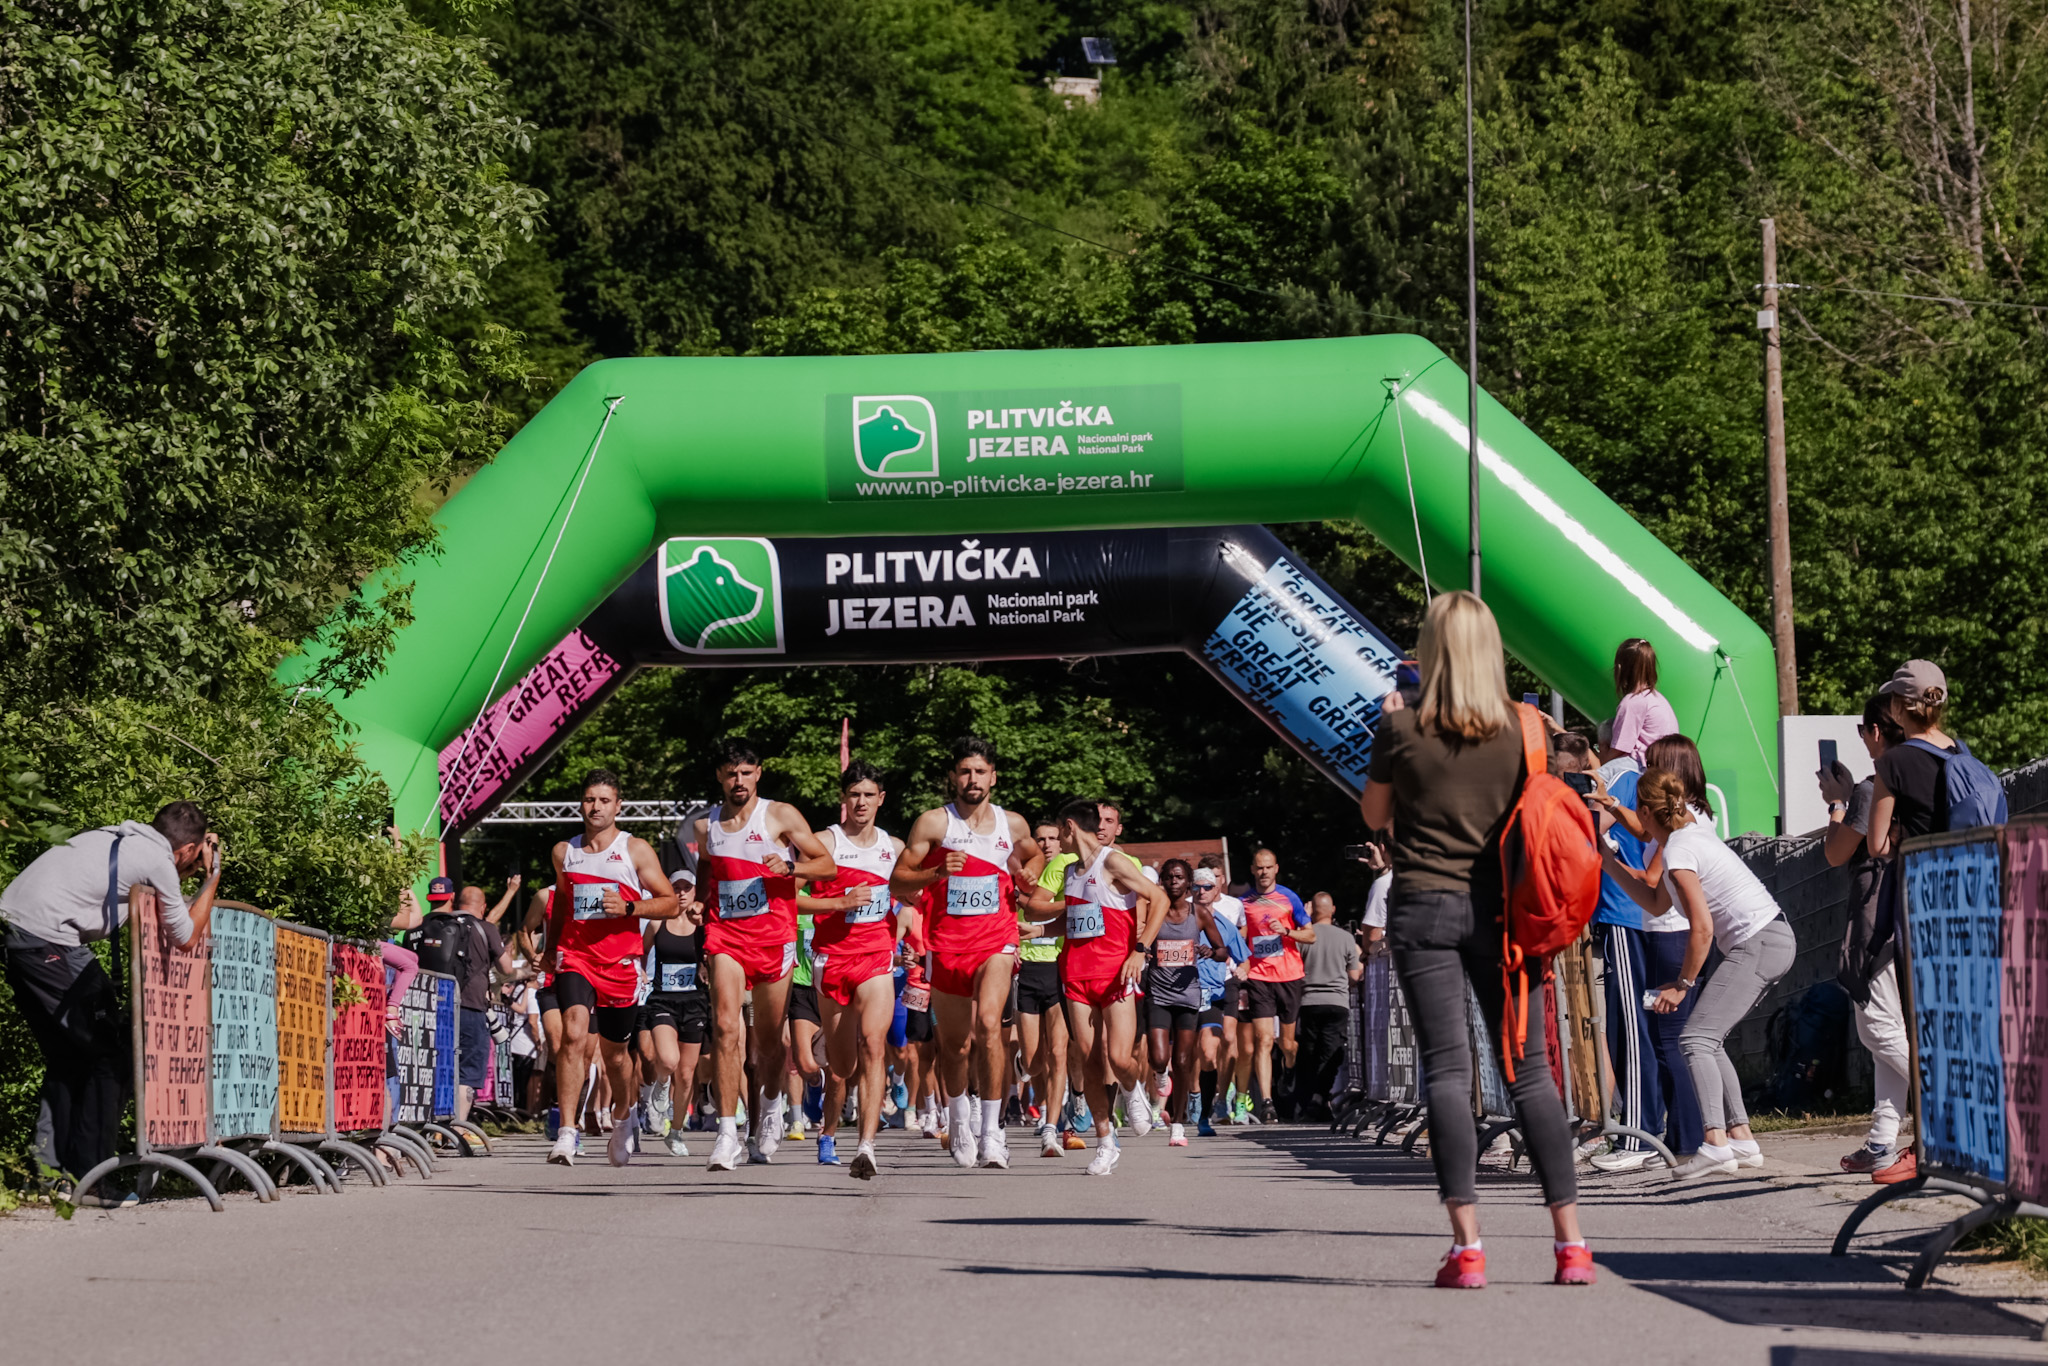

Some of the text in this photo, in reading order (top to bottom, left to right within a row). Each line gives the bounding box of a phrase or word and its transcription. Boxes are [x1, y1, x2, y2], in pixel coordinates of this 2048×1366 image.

[968, 400, 1114, 430] PLITVIČKA
[1077, 432, 1153, 444] Nacionalni park
[966, 435, 1070, 462] JEZERA
[1078, 443, 1144, 455] National Park
[856, 470, 1154, 498] www.np-plitvicka-jezera.hr
[825, 539, 1041, 585] PLITVIČKA
[987, 590, 1099, 609] Nacionalni park
[1281, 580, 1353, 637] GREAT
[825, 595, 976, 636] JEZERA
[989, 609, 1085, 625] National Park
[1231, 629, 1308, 691] GREAT
[1284, 642, 1336, 686] THE
[506, 651, 571, 724] GREAT
[580, 897, 600, 913] 44
[727, 892, 759, 911] 469
[957, 890, 992, 908] 468
[1070, 916, 1096, 932] 470
[1163, 950, 1188, 962] 194
[1257, 942, 1279, 954] 360
[669, 974, 693, 986] 537
